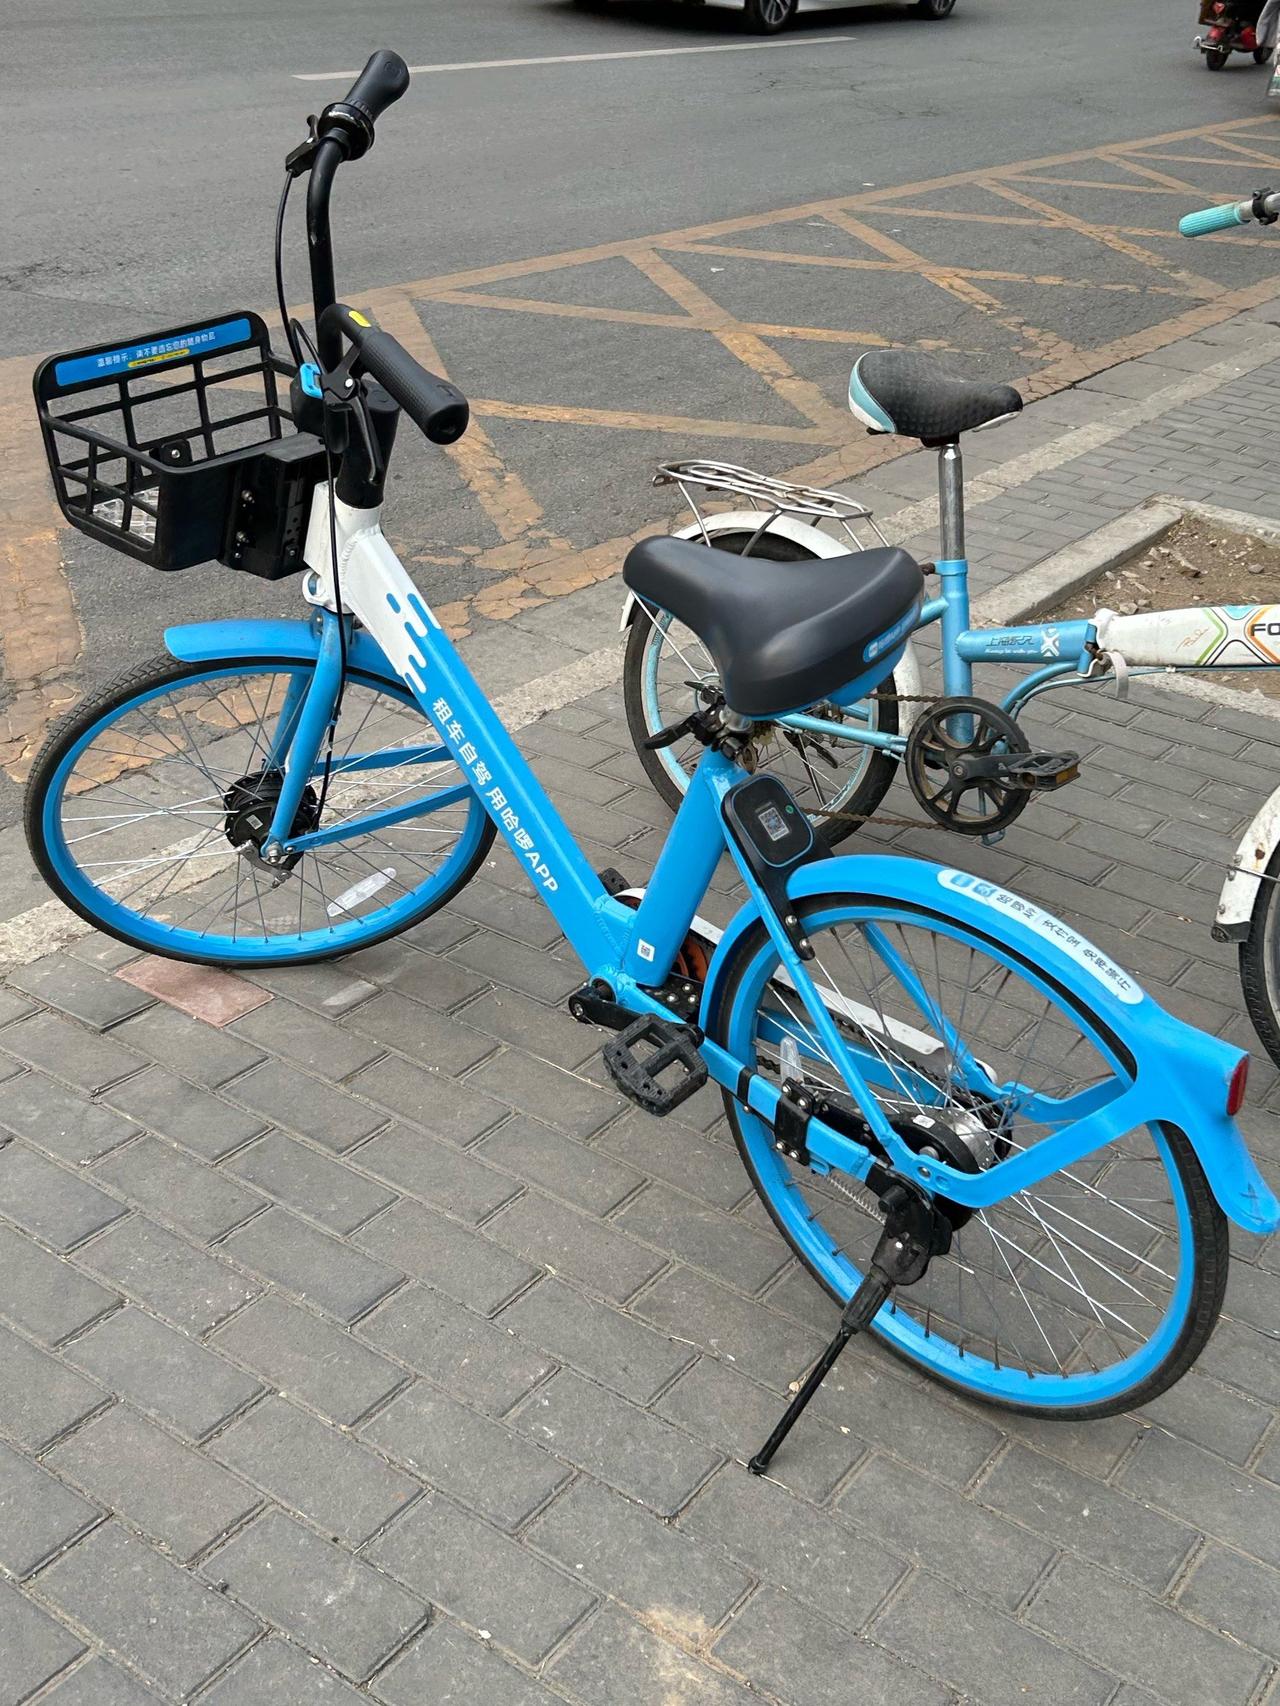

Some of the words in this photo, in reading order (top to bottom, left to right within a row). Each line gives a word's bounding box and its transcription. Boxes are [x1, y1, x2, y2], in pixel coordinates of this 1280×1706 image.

[432, 697, 492, 786] 租车自驾
[485, 786, 559, 892] 用哈啰APP
[1042, 919, 1081, 948] 支付宝
